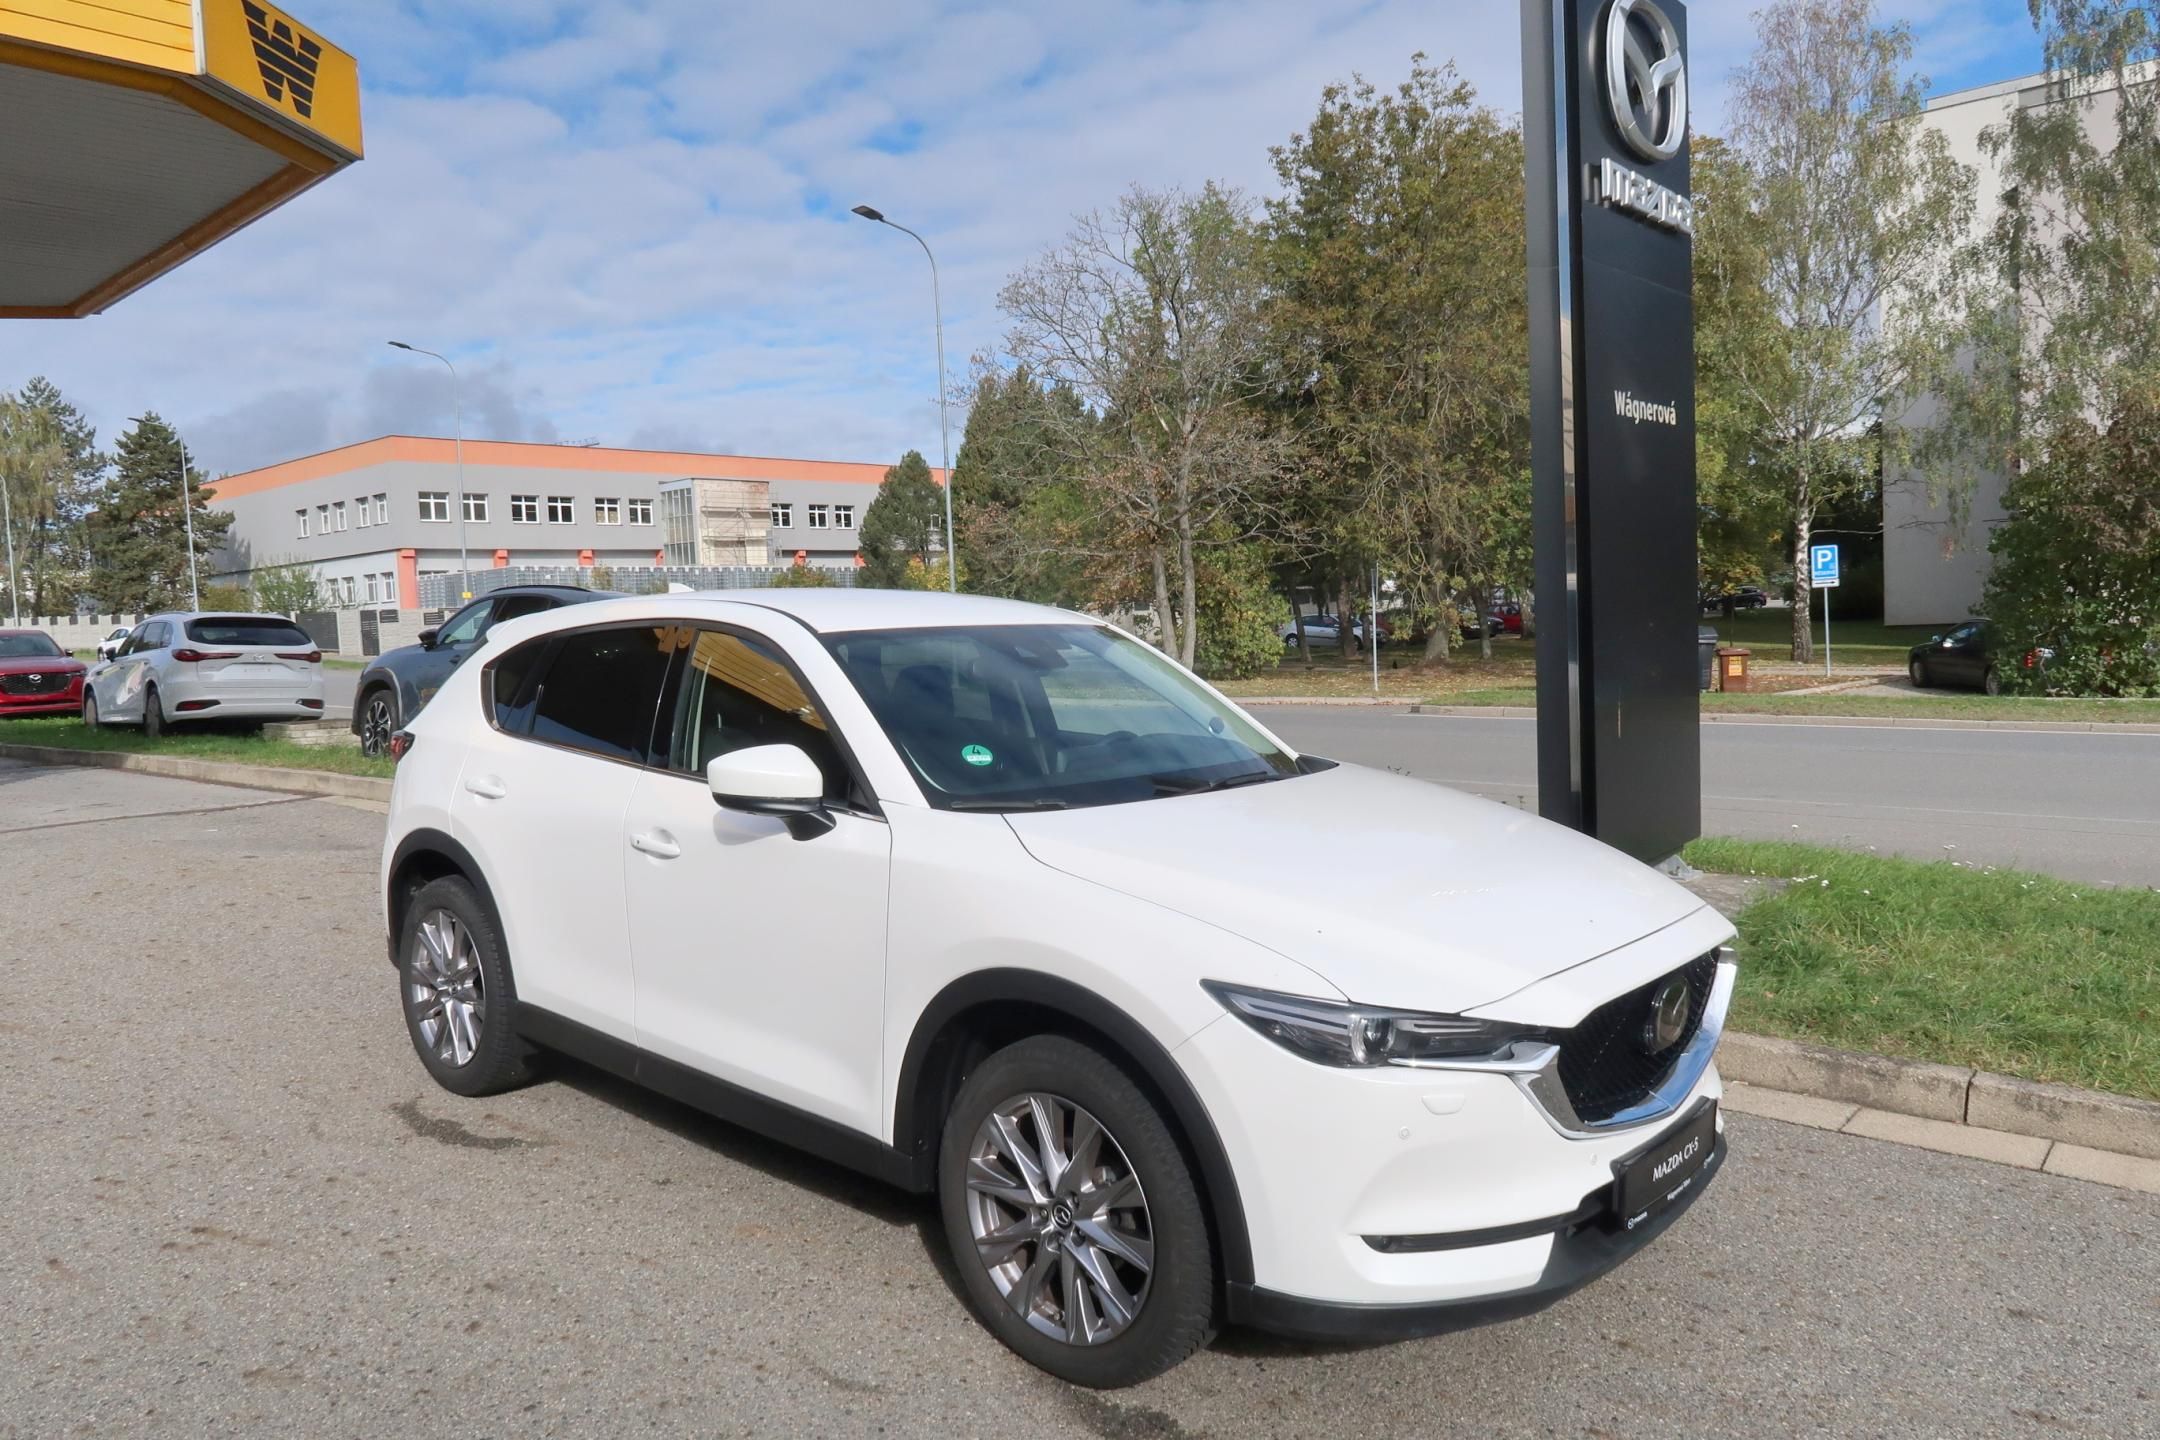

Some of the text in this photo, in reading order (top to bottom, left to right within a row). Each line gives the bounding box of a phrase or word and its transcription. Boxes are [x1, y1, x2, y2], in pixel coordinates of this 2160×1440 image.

[1614, 390, 1676, 425] Wágnerová
[1817, 549, 1833, 569] P
[1652, 1150, 1683, 1182] MAZDA
[1684, 1136, 1699, 1160] CX-5
